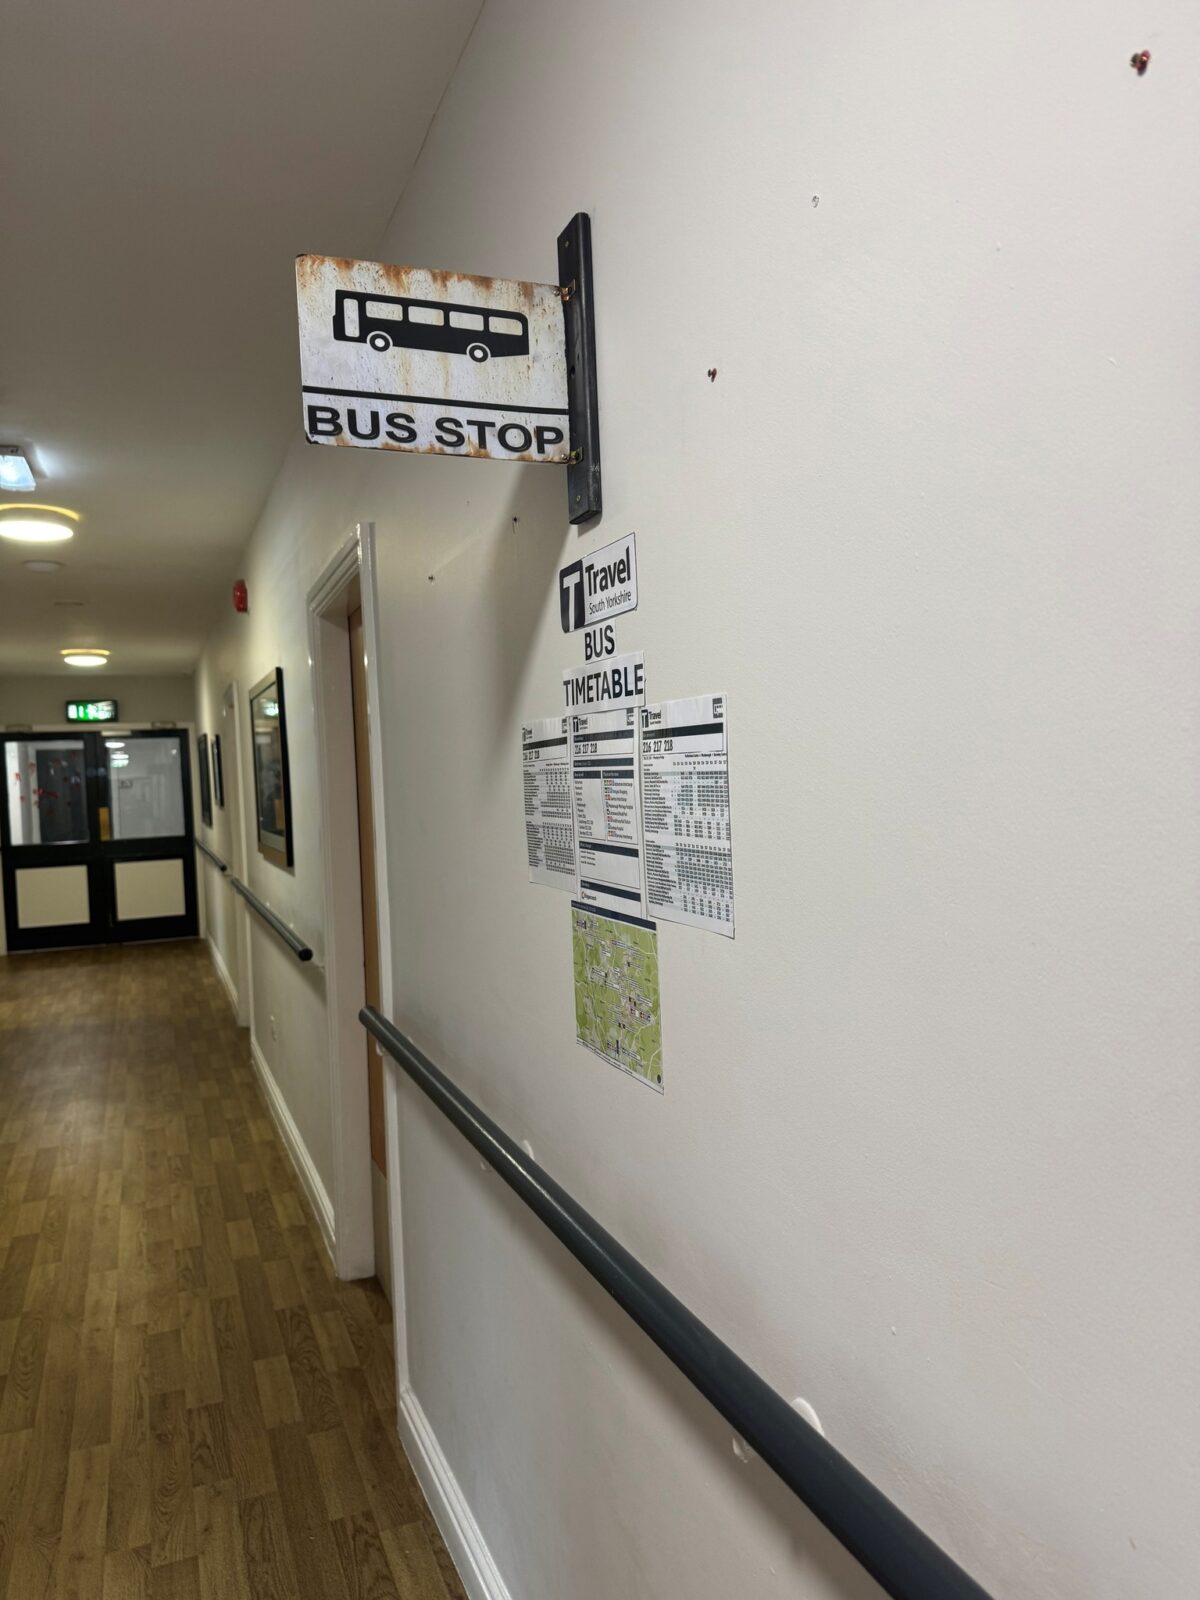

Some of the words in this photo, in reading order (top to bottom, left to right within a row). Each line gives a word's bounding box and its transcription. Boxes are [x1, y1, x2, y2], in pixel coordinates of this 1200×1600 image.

[307, 404, 417, 443] BUS
[435, 416, 564, 455] STOP
[585, 545, 631, 597] Travel
[589, 599, 605, 616] South
[605, 589, 632, 610] Yorkshire
[584, 624, 615, 661] BUS
[563, 663, 644, 707] TIMETABLE
[649, 709, 662, 720] Travel
[642, 741, 651, 753] 216
[653, 740, 662, 752] 217
[664, 739, 674, 751] 218
